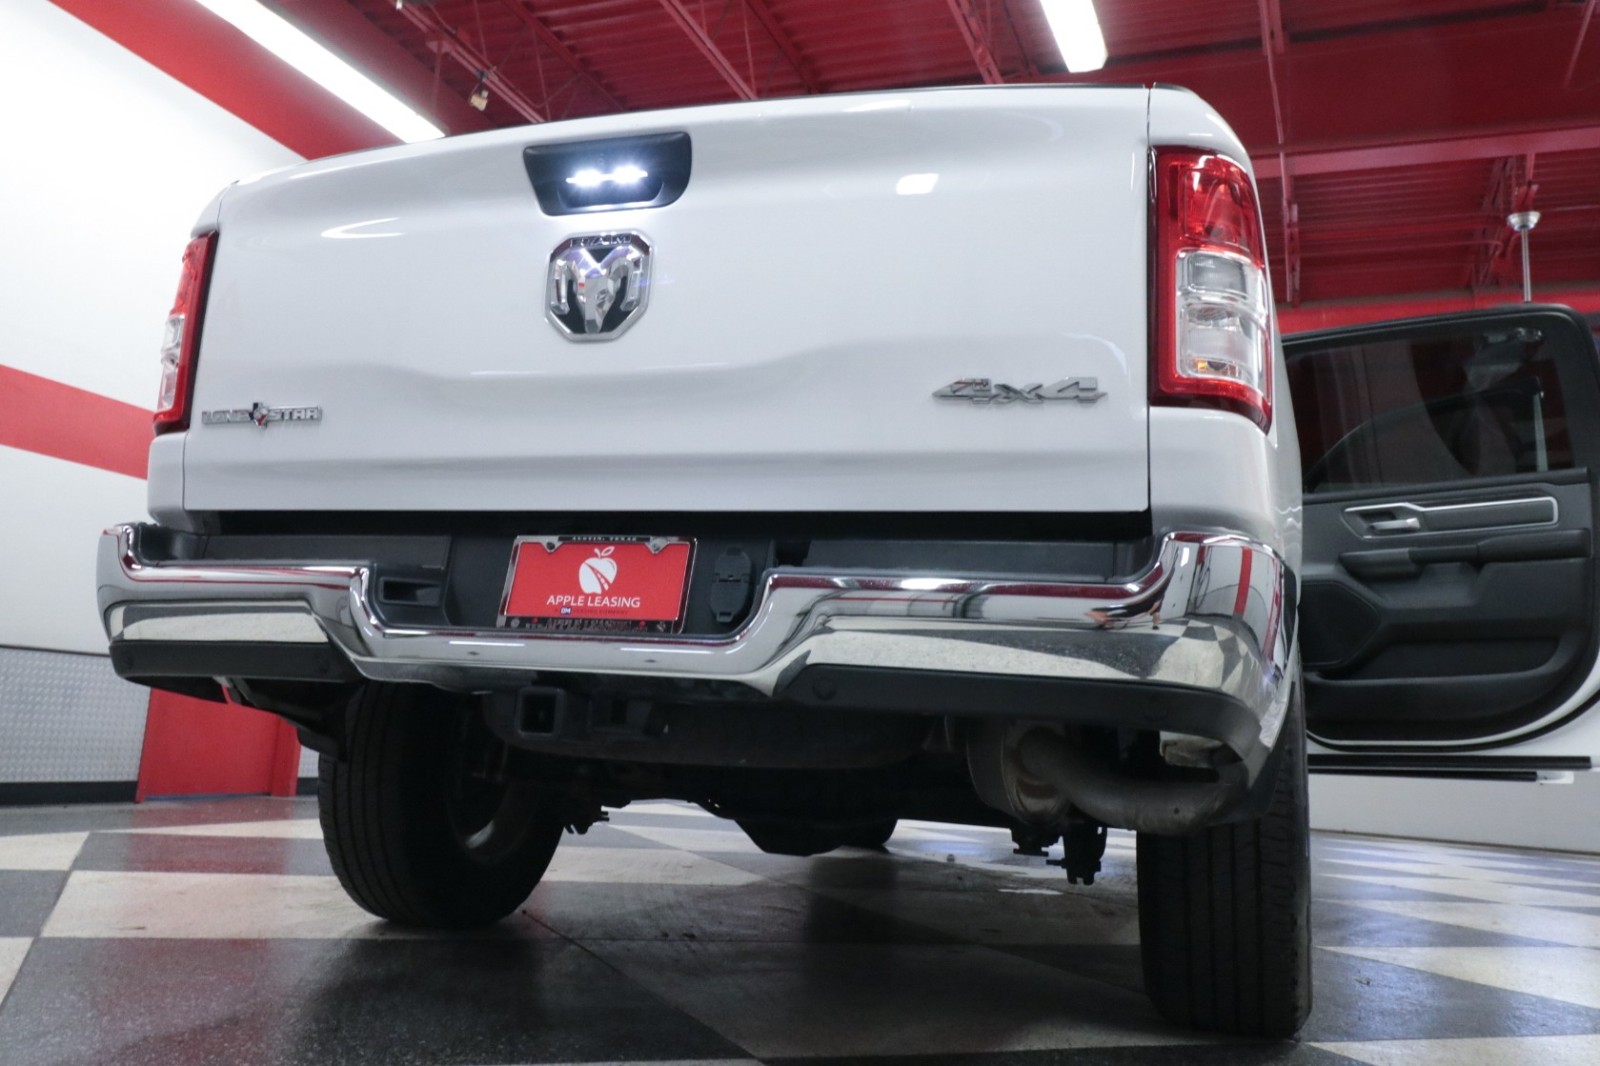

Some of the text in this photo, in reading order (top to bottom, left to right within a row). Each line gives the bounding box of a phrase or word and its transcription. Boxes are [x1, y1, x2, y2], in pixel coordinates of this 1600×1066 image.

[201, 407, 321, 424] LONE STAR
[546, 595, 641, 608] APPLE LEASING
